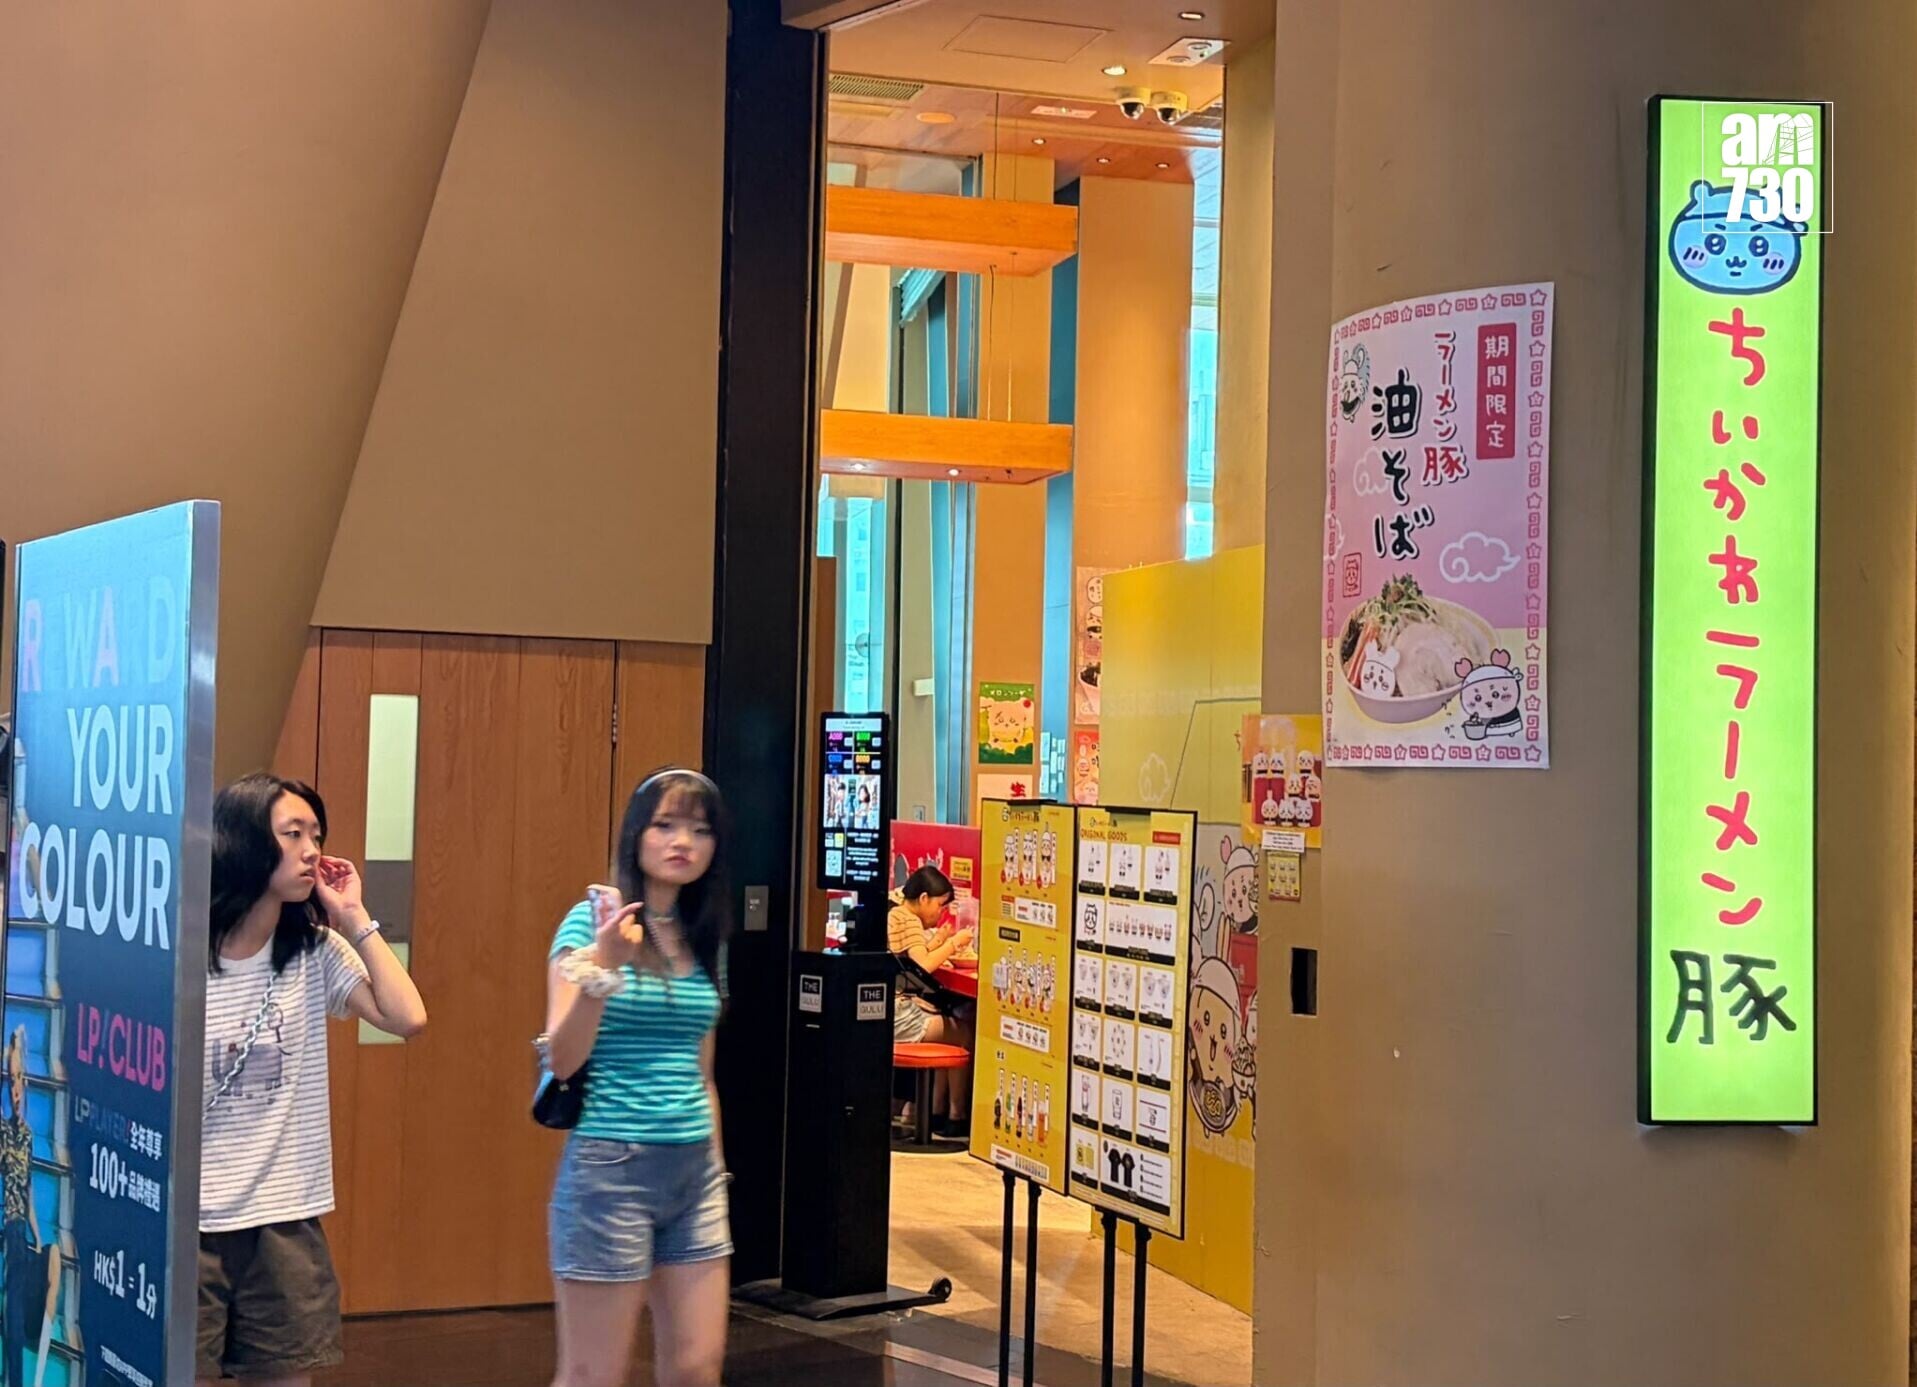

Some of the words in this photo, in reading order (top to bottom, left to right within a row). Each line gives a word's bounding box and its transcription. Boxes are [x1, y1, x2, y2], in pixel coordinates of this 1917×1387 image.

[1422, 331, 1466, 485] ラーメン豚
[1484, 335, 1509, 449] 期間限定
[1371, 368, 1433, 558] 油そば
[67, 703, 173, 815] YOUR
[19, 821, 171, 951] COLOUR
[864, 989, 881, 1000] THE
